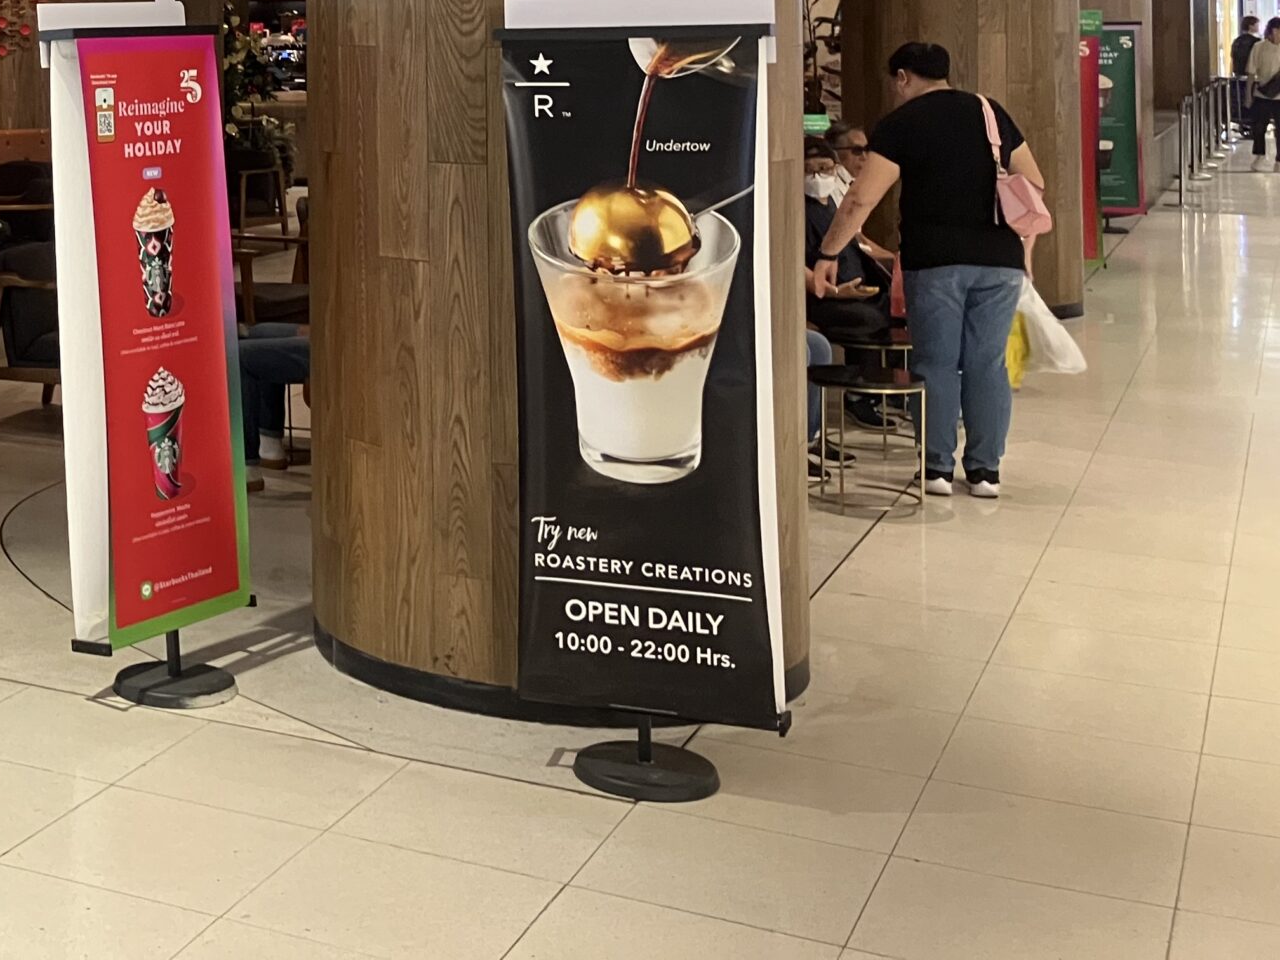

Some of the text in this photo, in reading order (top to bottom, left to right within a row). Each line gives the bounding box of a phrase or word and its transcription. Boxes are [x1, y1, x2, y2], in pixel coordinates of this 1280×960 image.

[118, 97, 185, 117] Reimagine
[533, 94, 554, 118] R
[134, 119, 171, 137] YOUR
[123, 139, 182, 159] HOLIDAY
[645, 139, 711, 153] Undertow
[146, 169, 158, 177] NEW
[531, 516, 598, 551] Try new
[534, 553, 753, 588] ROASTERY CREATIONS
[565, 598, 724, 636] OPEN DAILY
[554, 631, 612, 655] 10:00
[630, 639, 690, 664] 22:00
[696, 647, 736, 669] Hrs.
